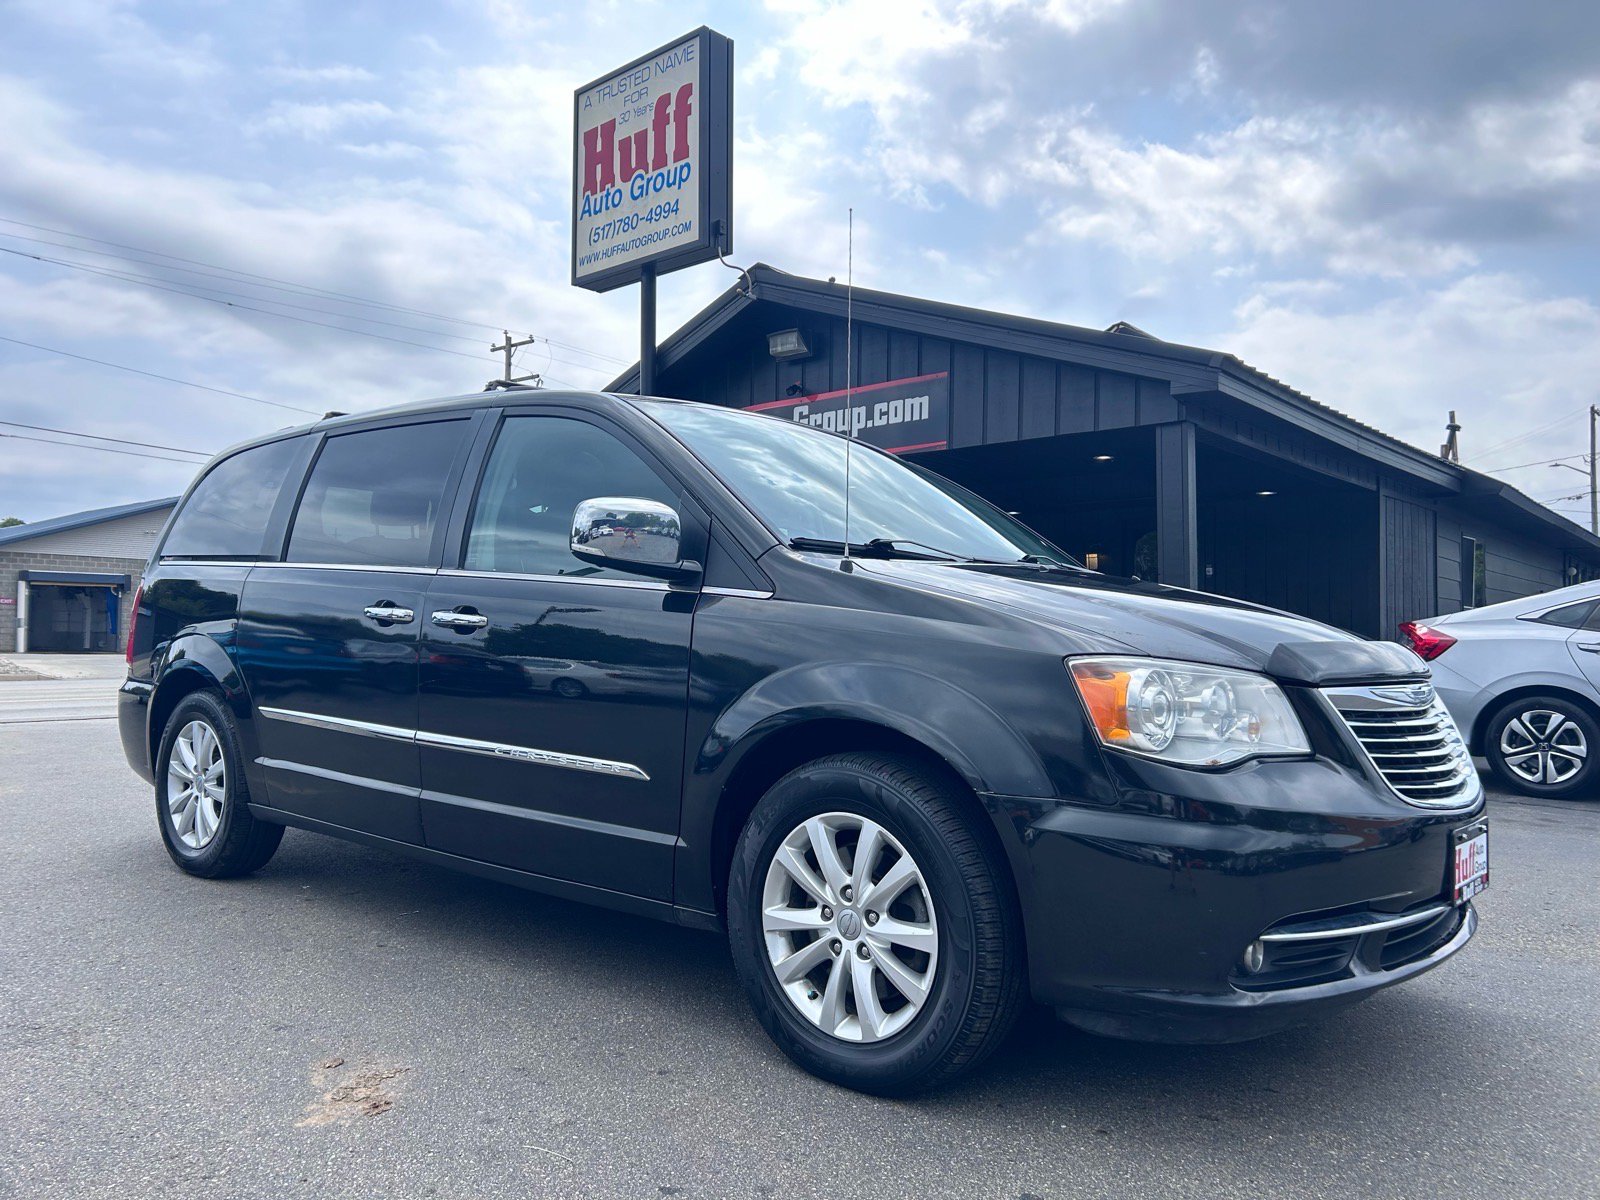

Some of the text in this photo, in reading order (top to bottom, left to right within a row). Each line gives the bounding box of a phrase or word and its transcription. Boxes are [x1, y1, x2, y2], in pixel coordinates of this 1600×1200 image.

[583, 44, 695, 111] A TRUSTED NAME
[623, 86, 649, 108] FOR
[618, 101, 655, 126] 30 Years
[582, 82, 693, 199] Huff
[579, 161, 692, 221] Auto Group
[578, 220, 692, 267] WWW.HUFFAUTOGROUP.COM
[588, 198, 680, 246] (517)780-4994
[494, 746, 621, 774] CHRYSLER
